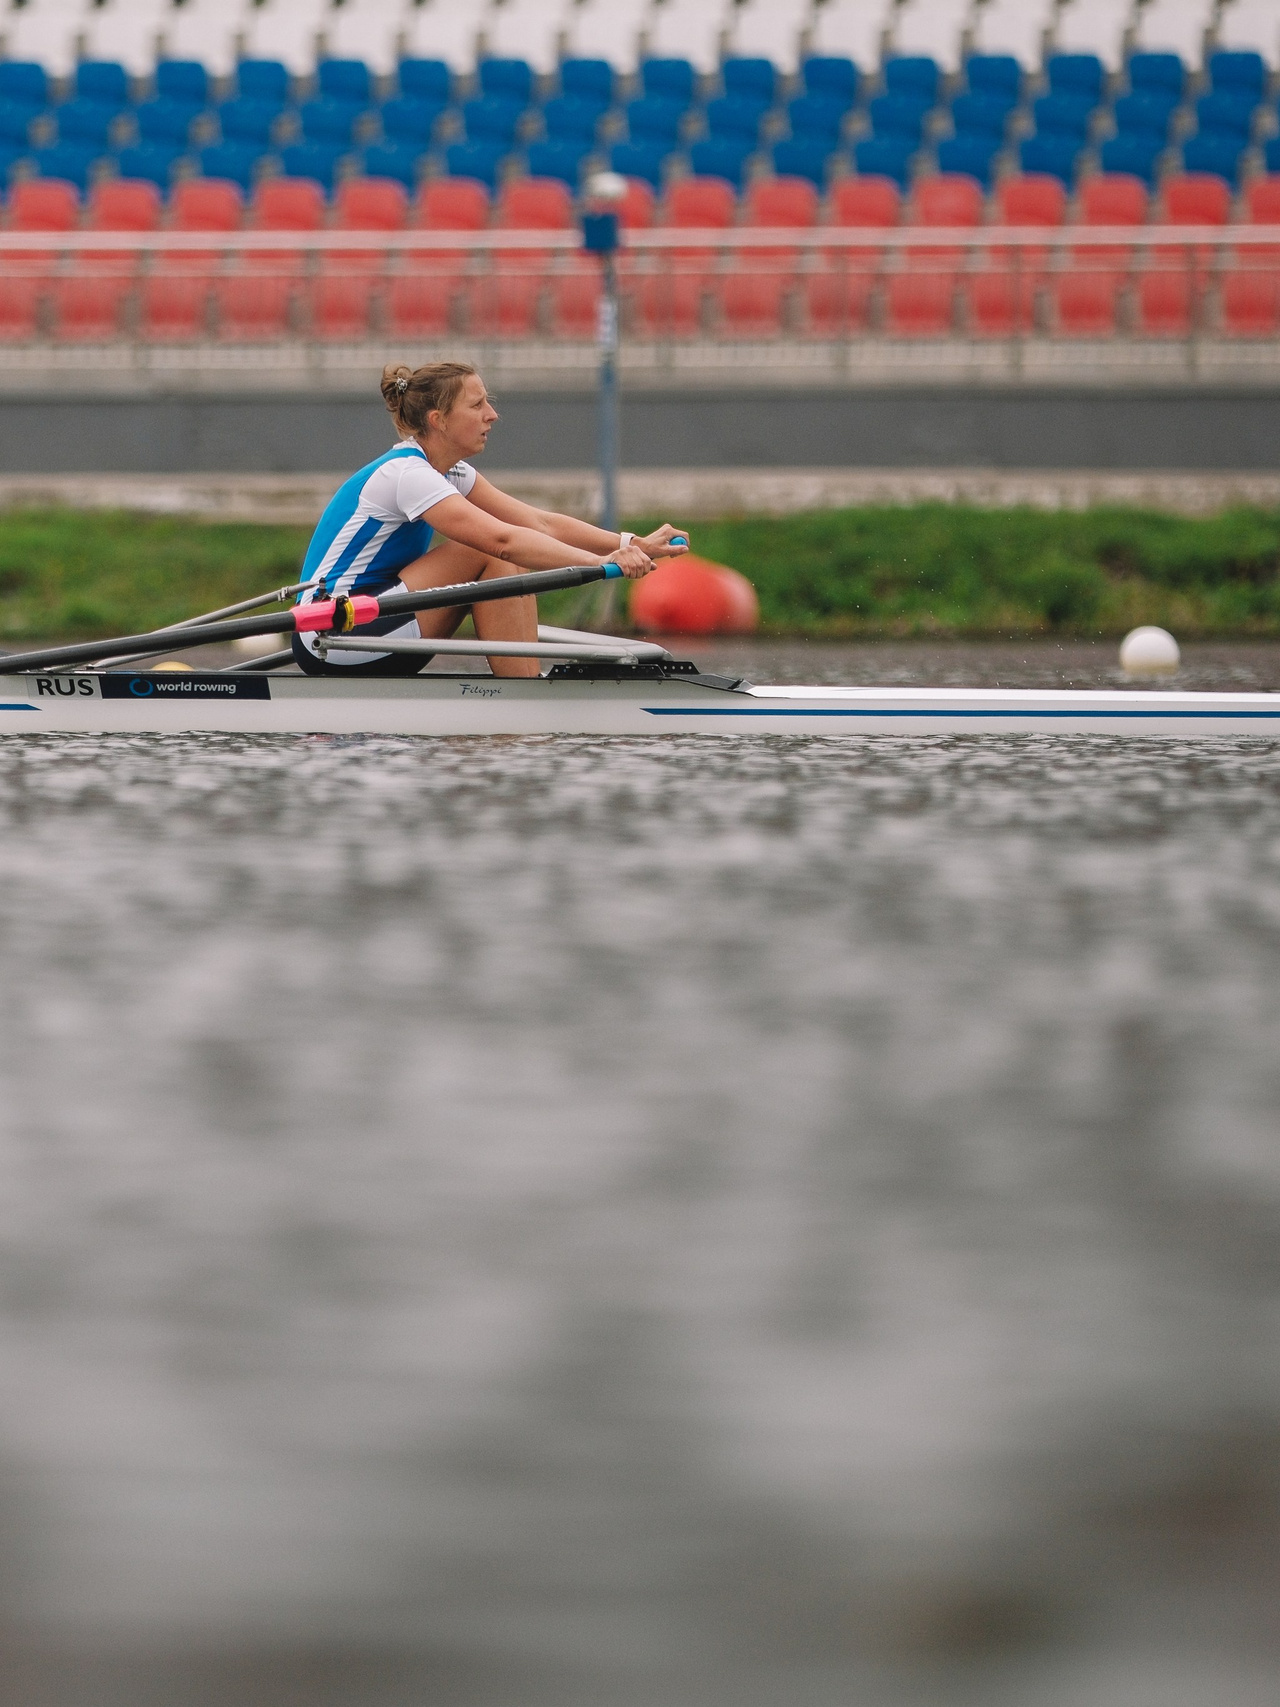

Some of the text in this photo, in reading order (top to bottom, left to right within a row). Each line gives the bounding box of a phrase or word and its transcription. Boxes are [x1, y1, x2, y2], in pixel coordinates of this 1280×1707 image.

[36, 678, 94, 696] RUS
[156, 681, 237, 695] world rowing
[459, 683, 502, 697] Filippi
